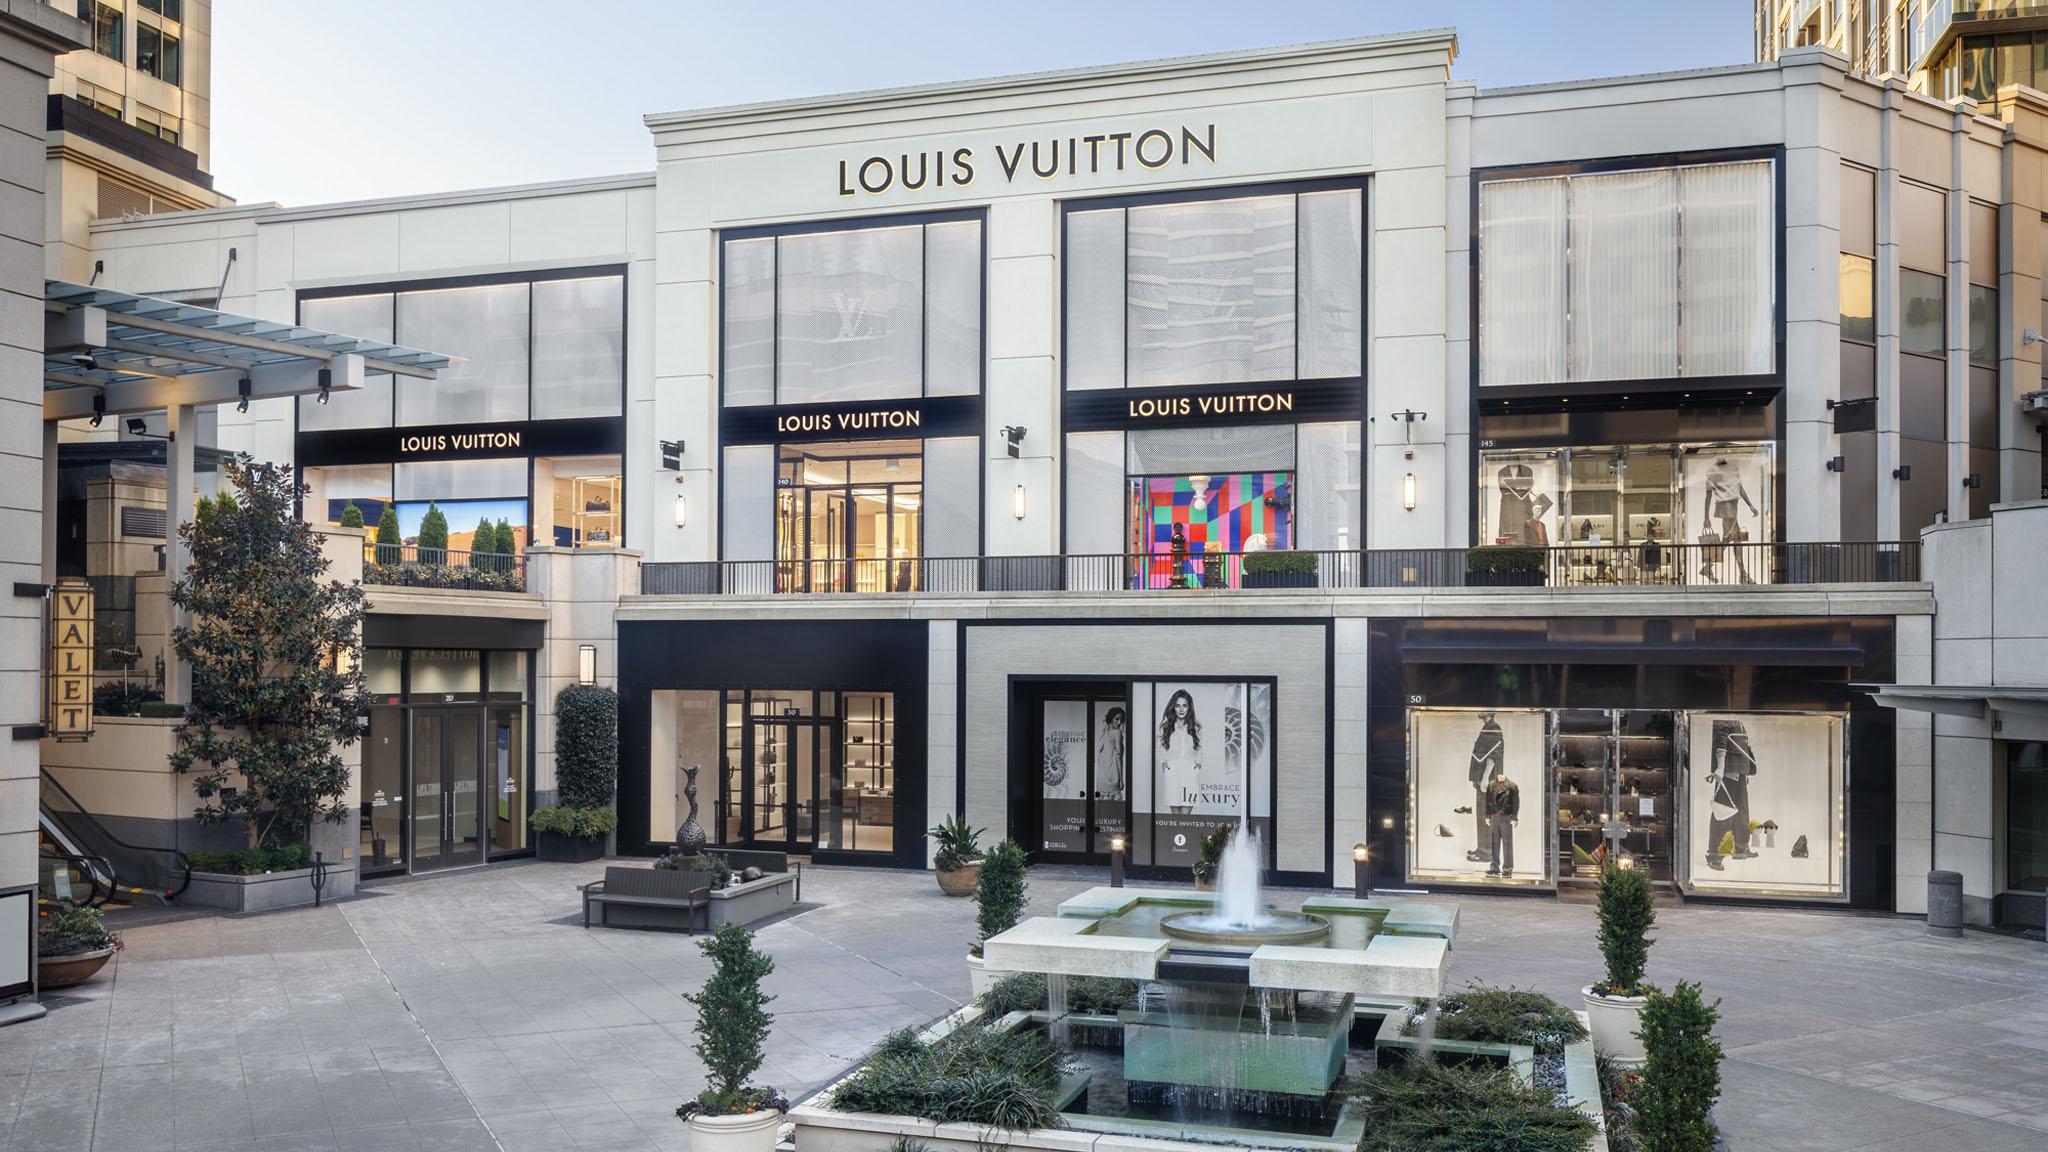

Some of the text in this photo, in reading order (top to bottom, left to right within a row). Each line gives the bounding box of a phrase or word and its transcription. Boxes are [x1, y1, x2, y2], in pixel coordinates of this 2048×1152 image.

[839, 124, 1216, 195] LOUIS VUITTON
[1129, 393, 1292, 417] LOUIS VUITTON
[778, 410, 920, 432] LOUIS VUITTON
[401, 432, 520, 452] LOUIS VUITTON
[62, 595, 84, 728] VALET
[1410, 695, 1422, 703] 50
[1045, 732, 1087, 745] elegance
[1182, 786, 1241, 807] luxury
[1200, 783, 1240, 792] EMBRACE
[1179, 820, 1205, 828] INVITED
